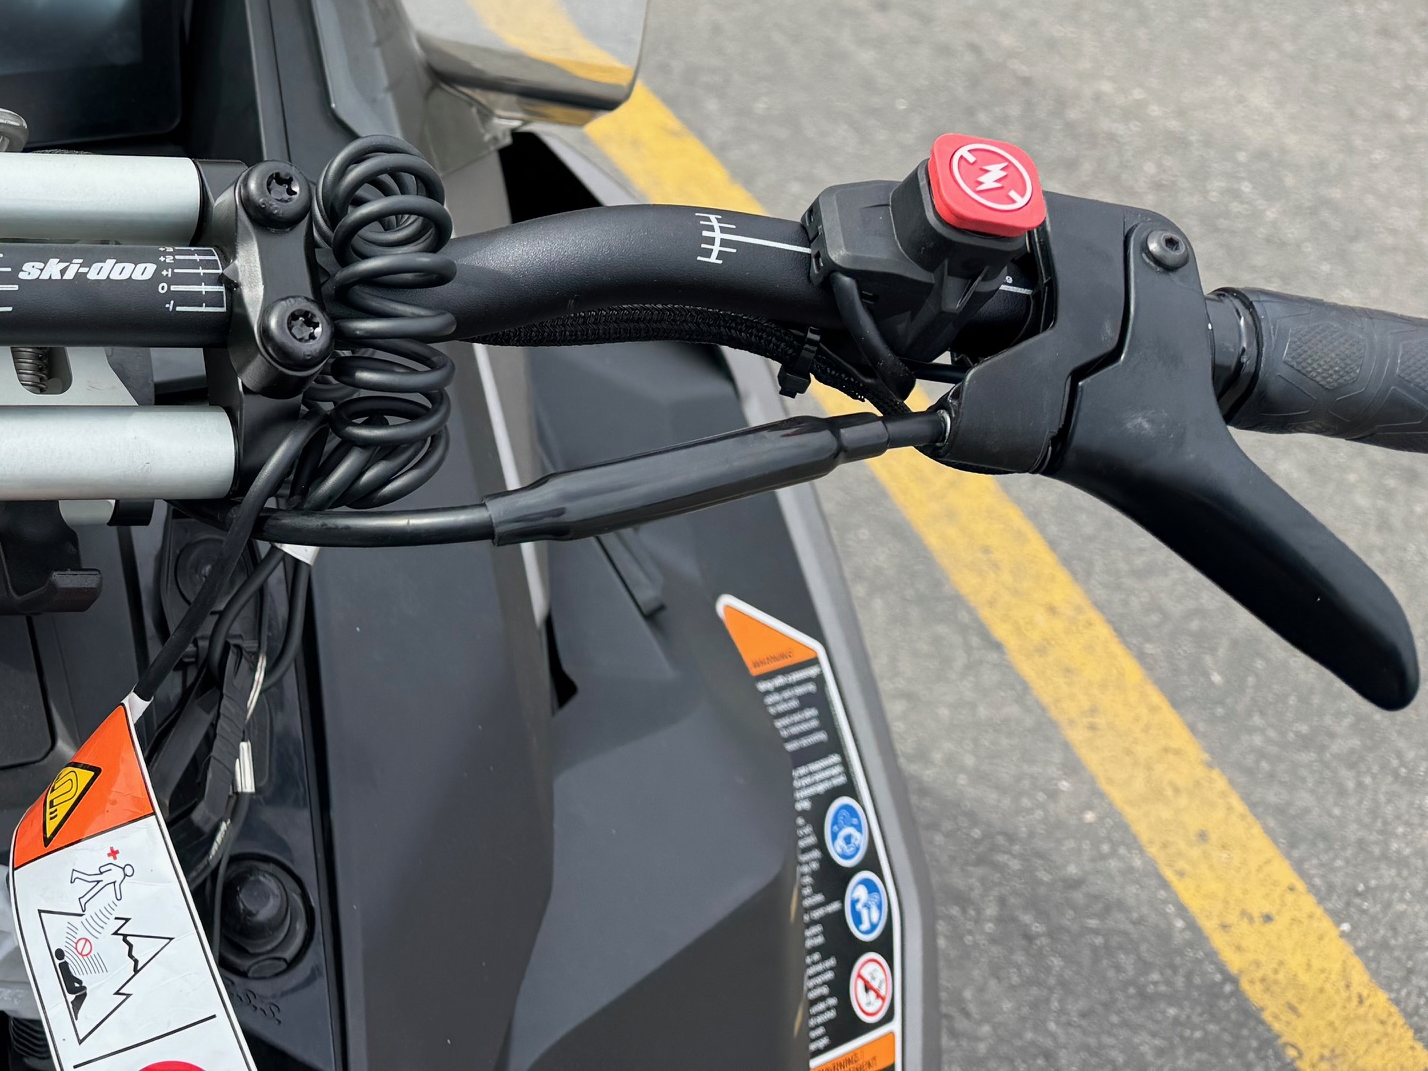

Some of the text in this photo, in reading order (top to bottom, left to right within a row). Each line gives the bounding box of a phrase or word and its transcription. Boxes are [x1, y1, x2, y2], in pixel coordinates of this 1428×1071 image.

[158, 255, 174, 263] +2
[18, 258, 157, 280] ski-doo
[161, 268, 172, 278] +1
[158, 282, 168, 294] 0
[165, 300, 174, 312] -1
